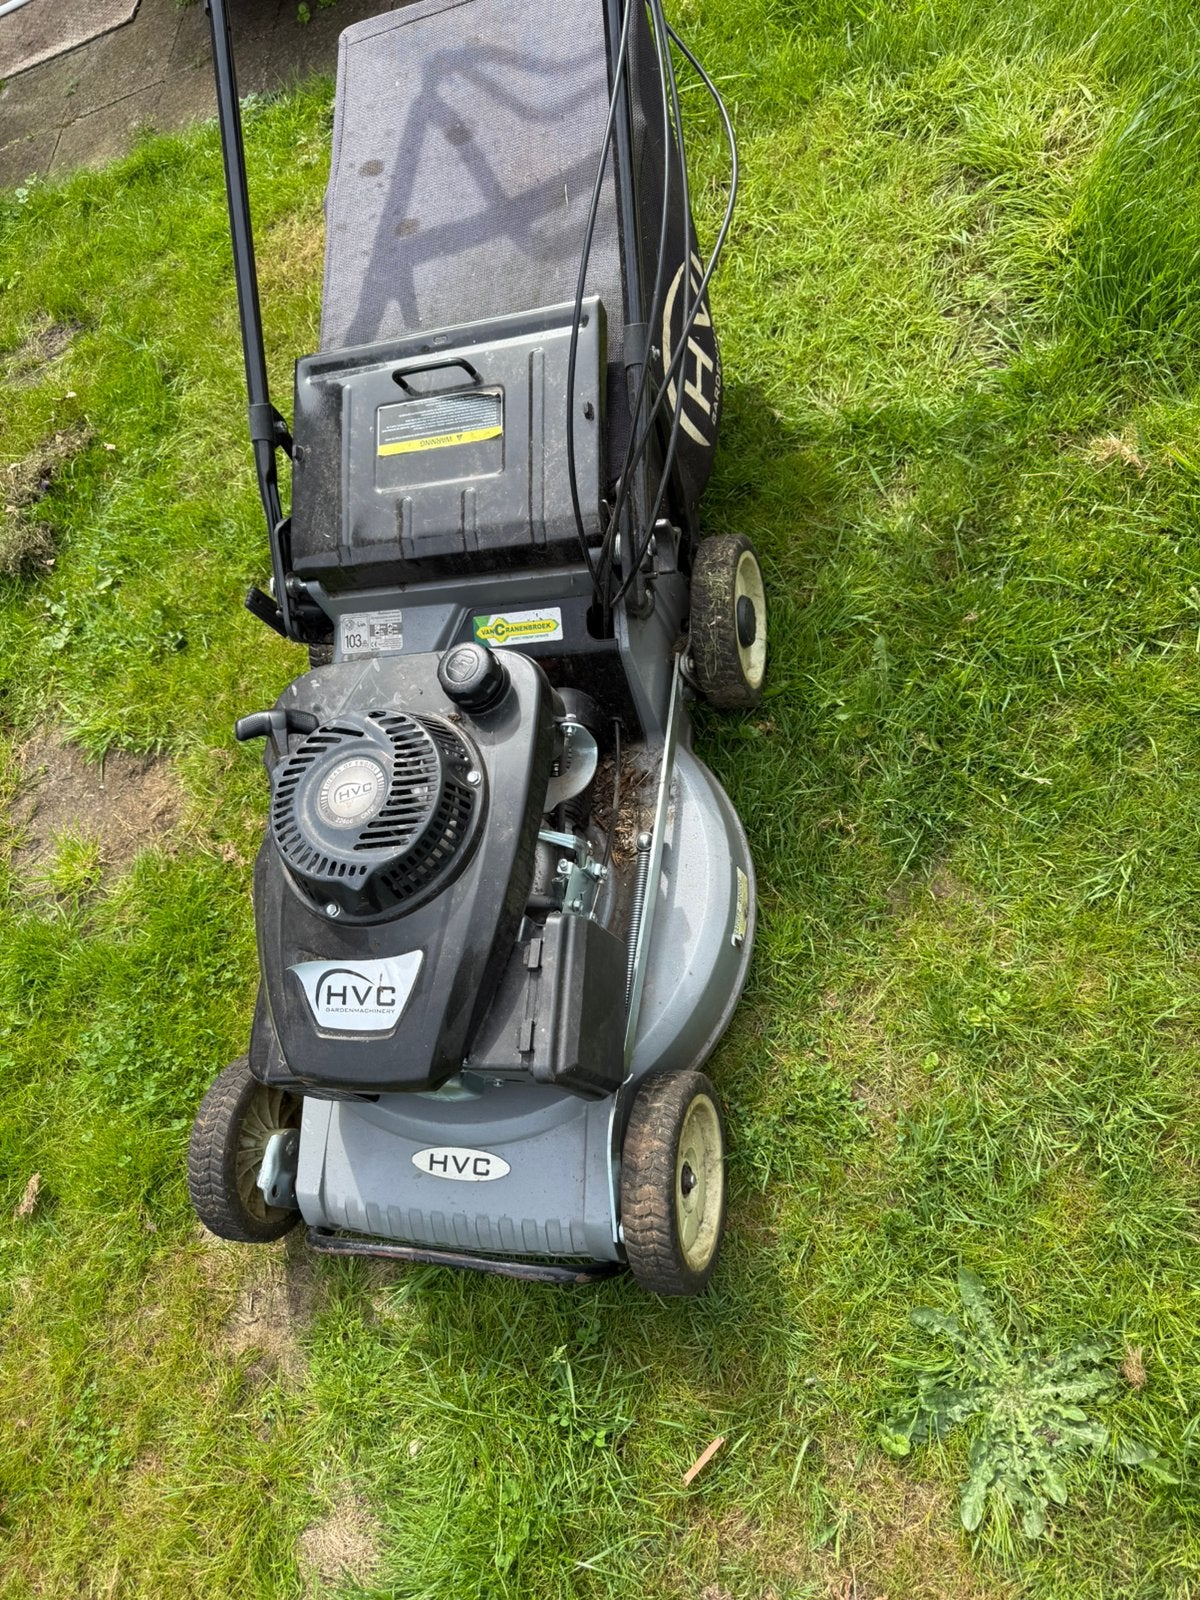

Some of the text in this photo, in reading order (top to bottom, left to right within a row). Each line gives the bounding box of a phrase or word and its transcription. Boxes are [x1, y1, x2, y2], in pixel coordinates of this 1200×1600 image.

[419, 435, 453, 447] WARNING
[494, 622, 552, 636] CRANENBROEK
[345, 633, 362, 649] 103
[339, 782, 373, 800] HVC
[326, 984, 396, 1007] HVC
[428, 1153, 491, 1177] HVC
